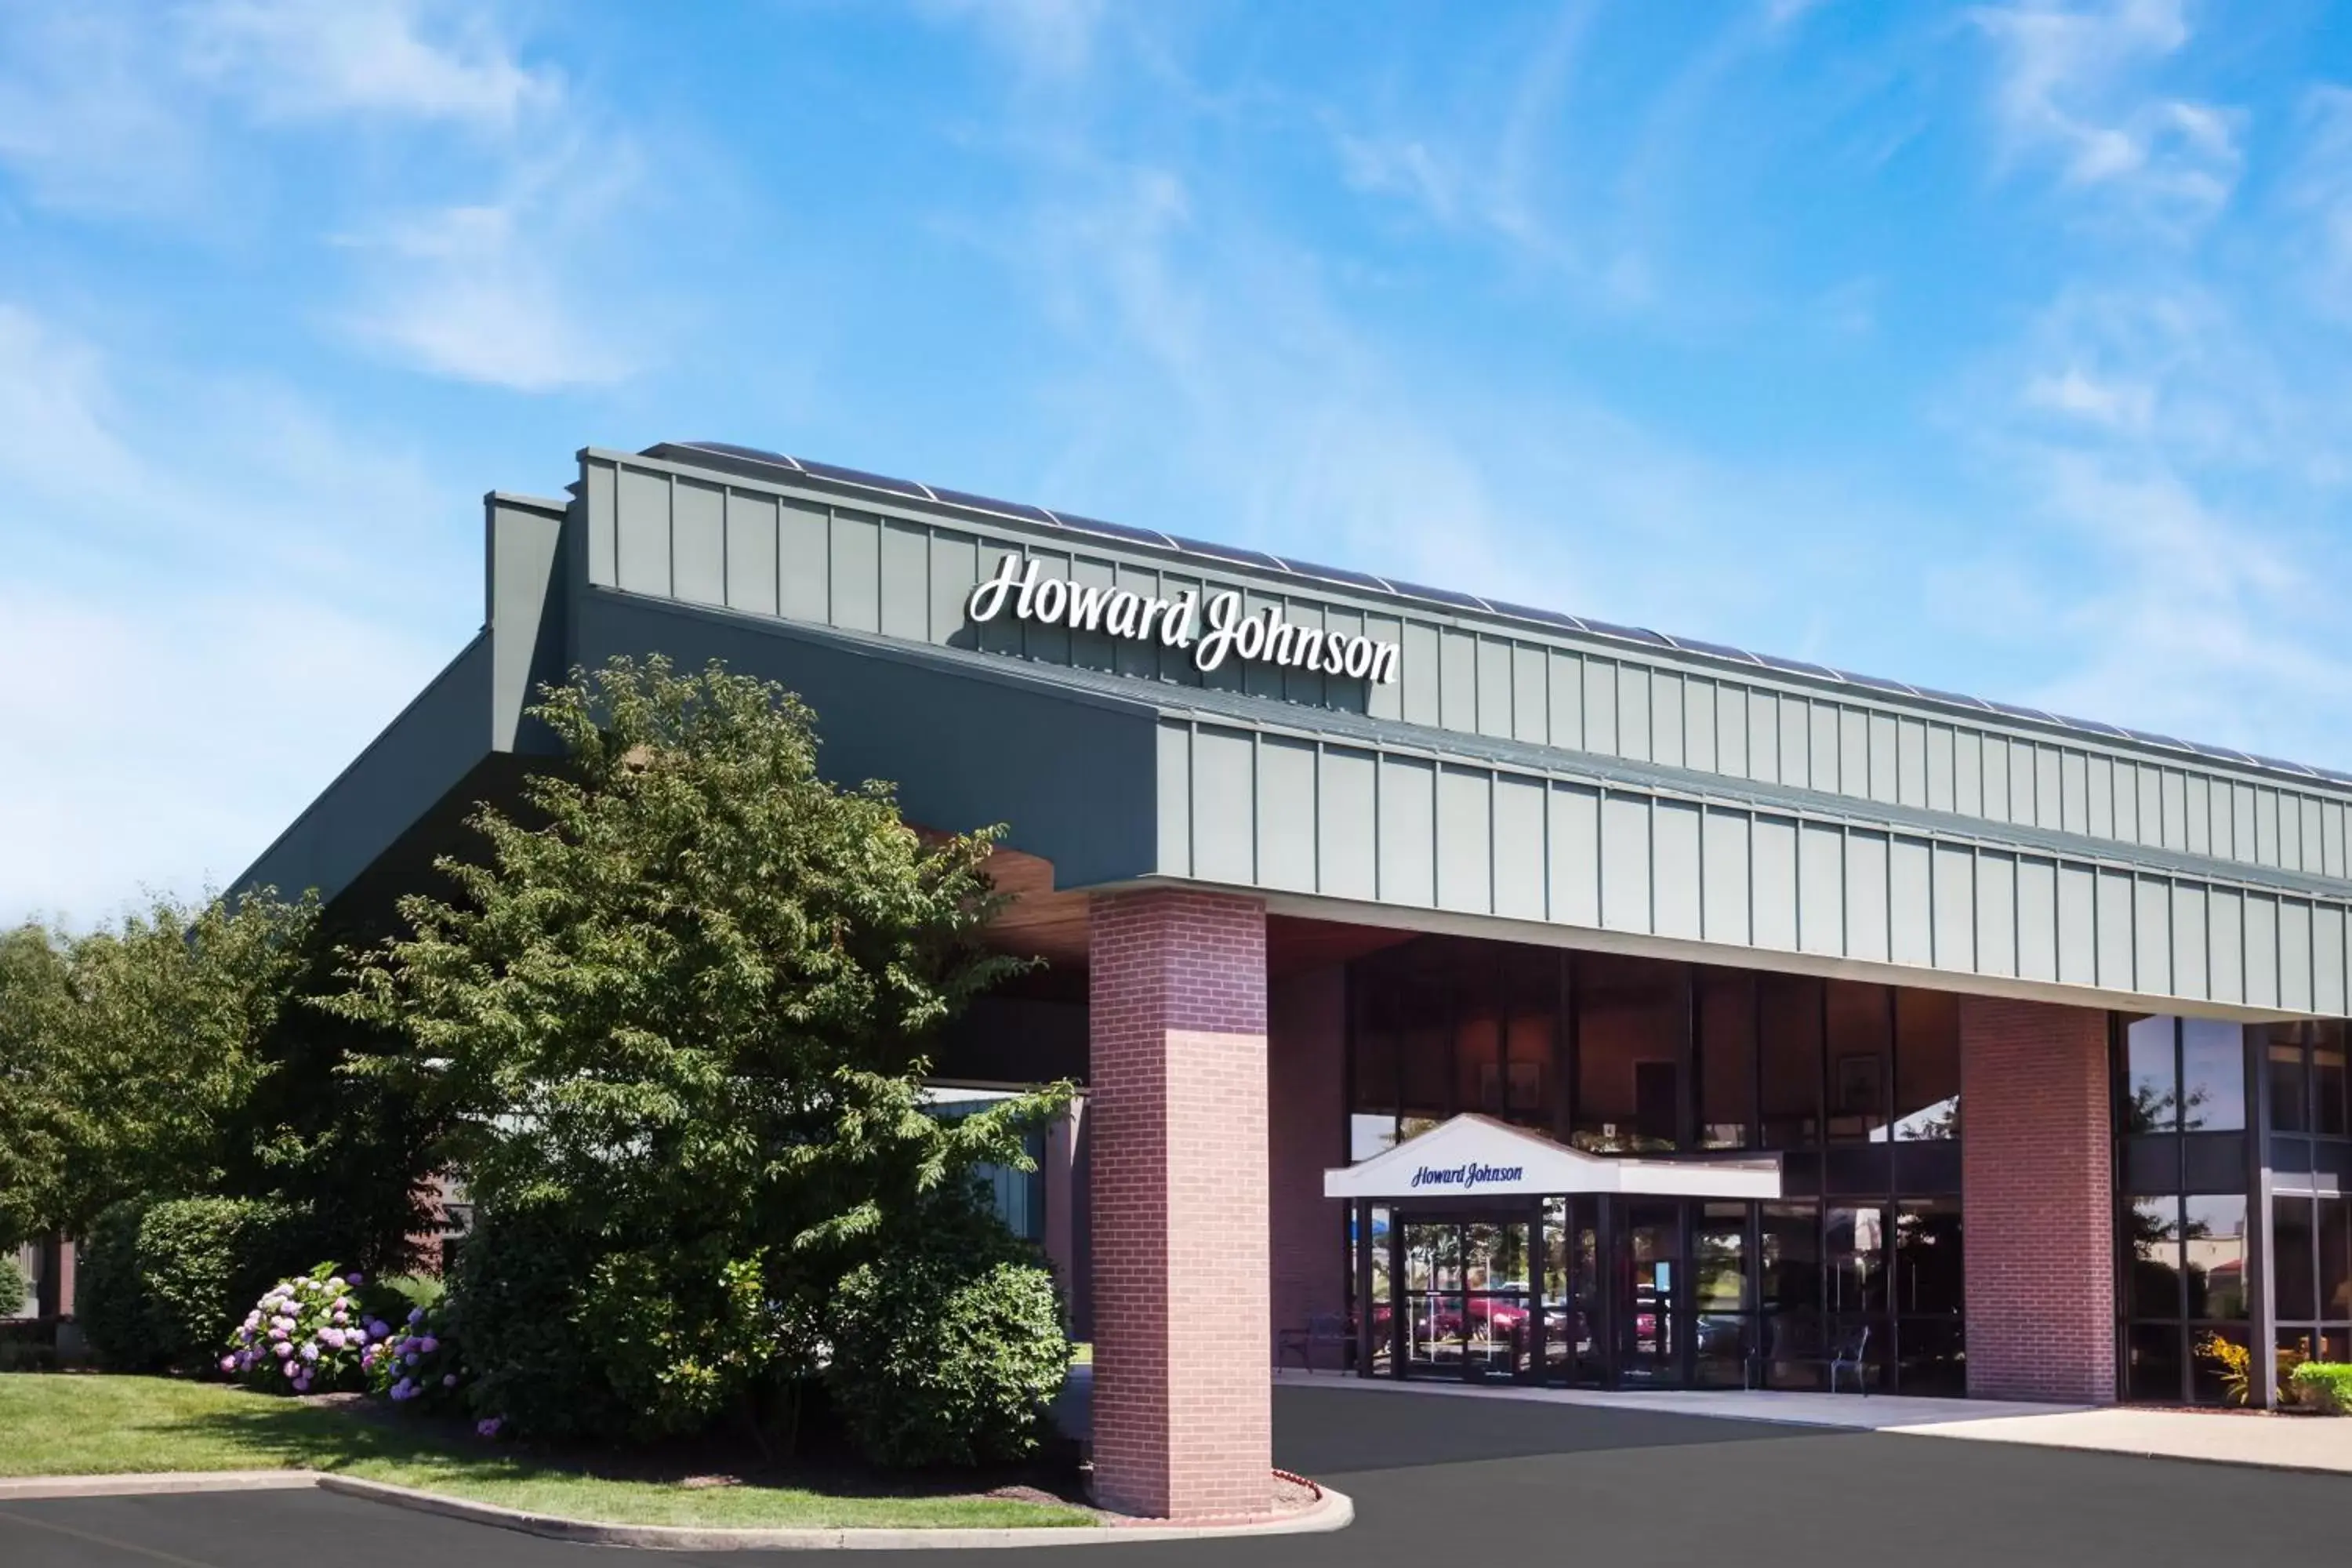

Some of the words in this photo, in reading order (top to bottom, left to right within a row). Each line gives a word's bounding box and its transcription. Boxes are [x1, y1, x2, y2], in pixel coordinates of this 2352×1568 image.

[970, 554, 1196, 648] Howard
[1196, 591, 1399, 684] Johnson
[1411, 1165, 1465, 1188] Howard
[1465, 1163, 1523, 1189] Johnson
